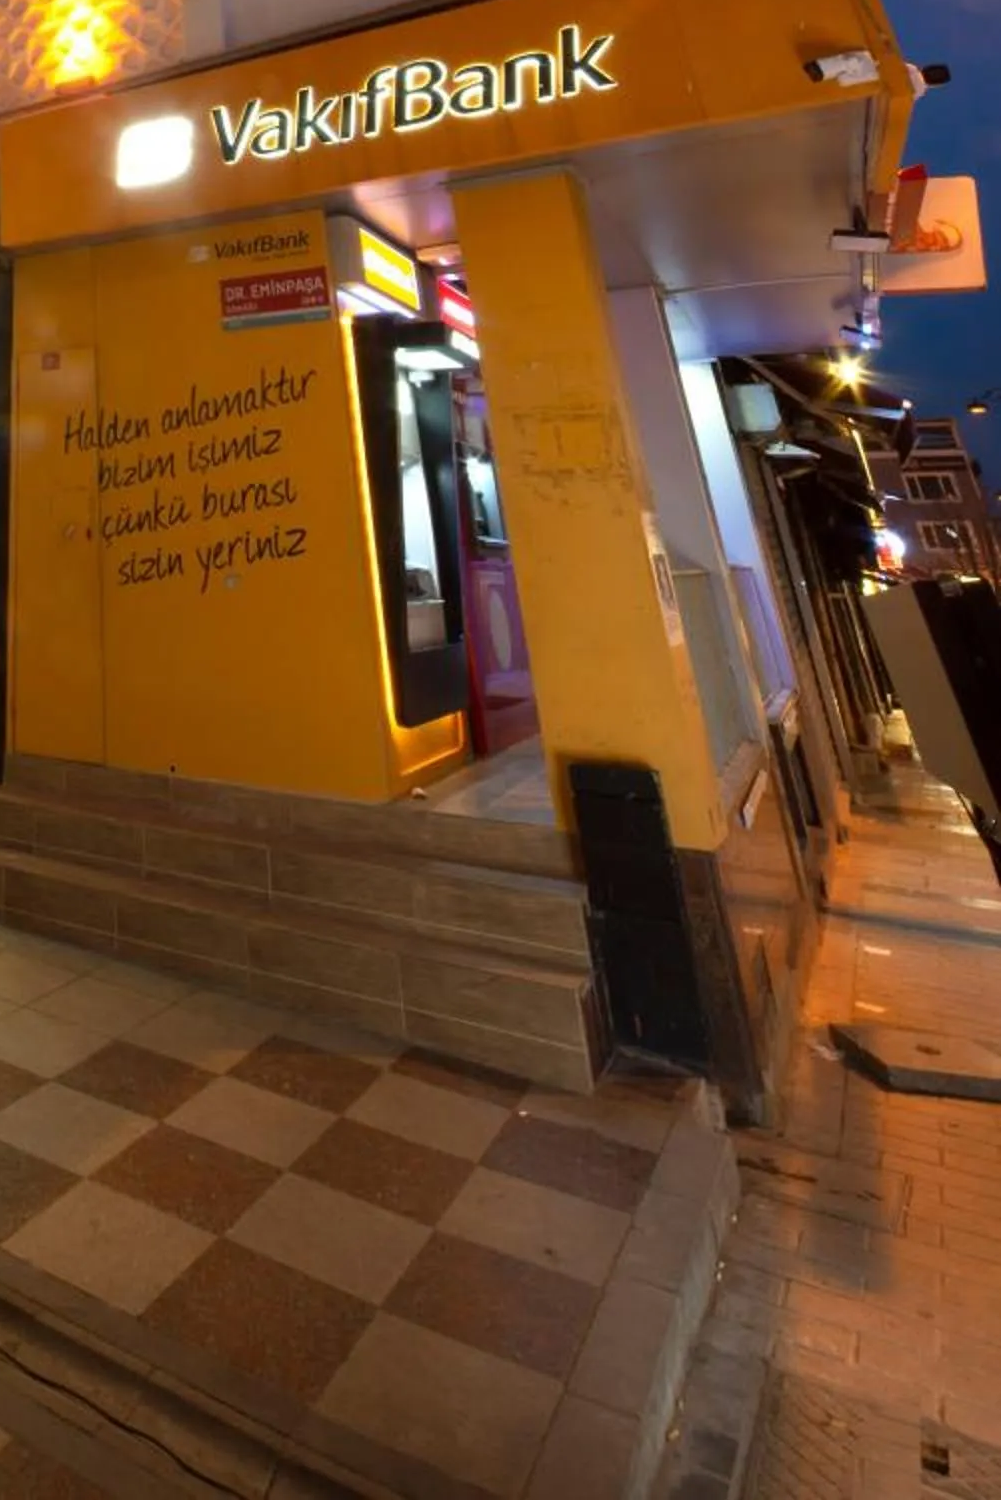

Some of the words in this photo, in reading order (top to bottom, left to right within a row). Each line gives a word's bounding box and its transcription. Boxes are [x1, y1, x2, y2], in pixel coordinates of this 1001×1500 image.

[210, 25, 618, 165] VakıfBank
[214, 230, 310, 258] VakıfBank
[224, 285, 247, 303] DR.
[250, 276, 325, 299] EMİNPAŞA
[64, 406, 151, 454] Halden
[161, 365, 317, 435] anlamaktır
[98, 457, 176, 493] bizim
[187, 426, 282, 476] işimiz
[101, 489, 191, 548] çünkü
[201, 477, 298, 521] burası
[117, 547, 185, 586] sizin
[195, 525, 308, 595] yeriniz
